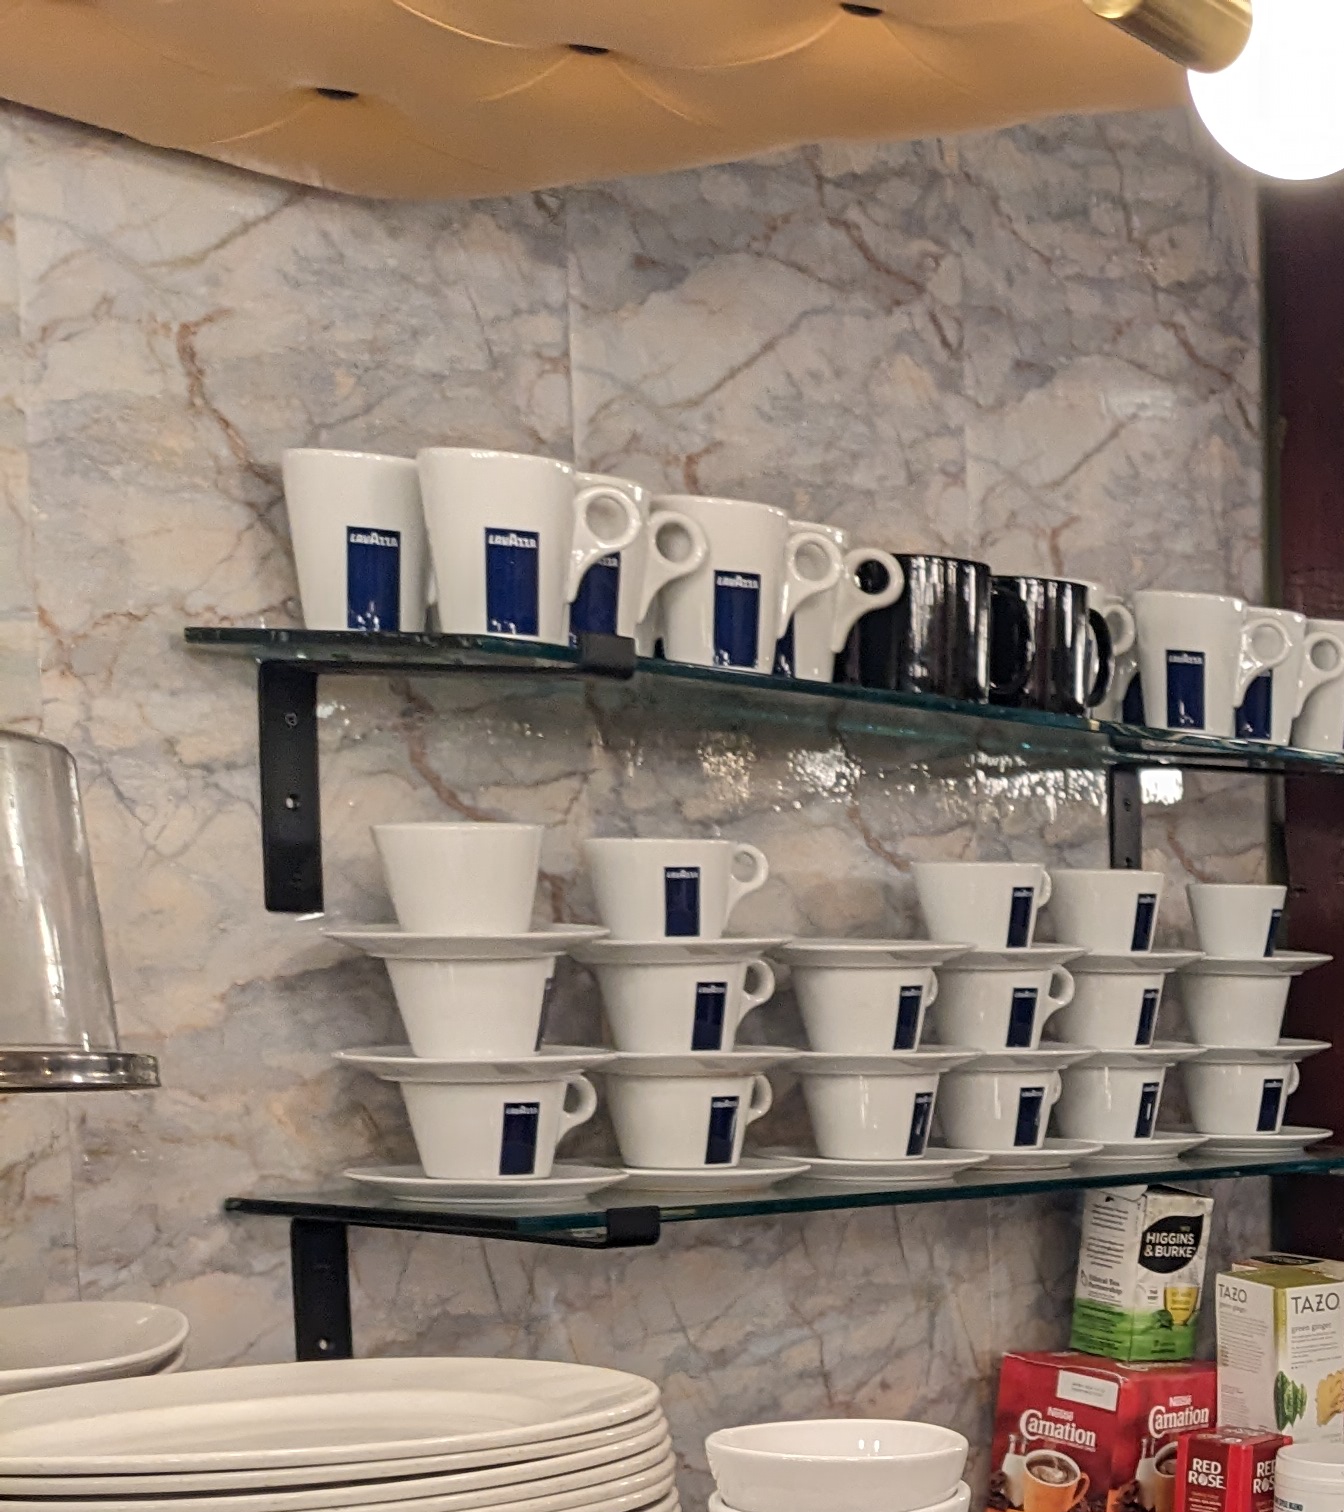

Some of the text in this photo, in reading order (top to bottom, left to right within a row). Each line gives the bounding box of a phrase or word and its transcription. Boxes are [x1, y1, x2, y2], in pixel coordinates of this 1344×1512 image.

[1146, 1232, 1195, 1245] HIGGINS
[1145, 1244, 1194, 1259] & BURKE
[1019, 1408, 1097, 1447] Carnation
[1148, 1405, 1210, 1438] Carnation
[1192, 1458, 1222, 1475] RED
